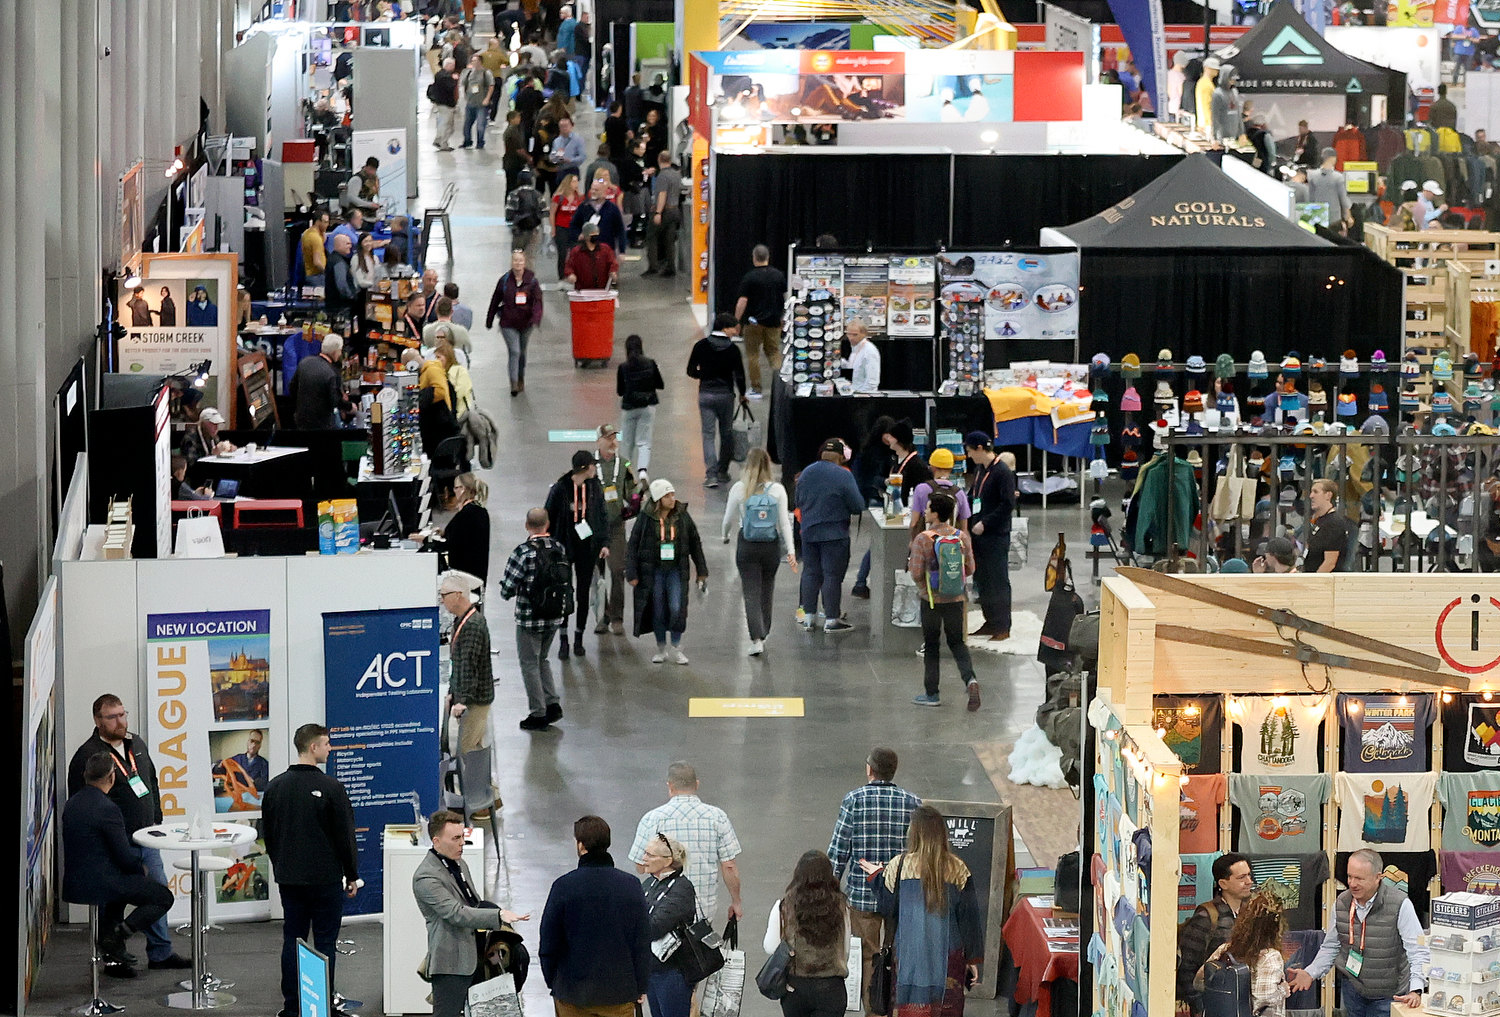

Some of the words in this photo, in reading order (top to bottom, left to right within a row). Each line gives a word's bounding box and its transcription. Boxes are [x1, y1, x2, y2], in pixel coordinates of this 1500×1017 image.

[1174, 202, 1238, 215] GOLD
[1150, 215, 1266, 229] NATURALS
[143, 333, 173, 343] STORM
[176, 333, 204, 343] CREEK
[156, 624, 188, 636] NEW
[190, 620, 256, 634] LOCATION
[356, 650, 431, 689] ACT
[1365, 708, 1391, 717] WINTER
[1393, 708, 1416, 716] PARK
[157, 646, 188, 816] PRAGUE
[1257, 754, 1295, 765] CHATTANOOGA
[1361, 745, 1413, 762] Colorado
[947, 819, 976, 830] WILL
[1436, 904, 1468, 914] STICKERS
[1476, 902, 1499, 917] STICKERS
